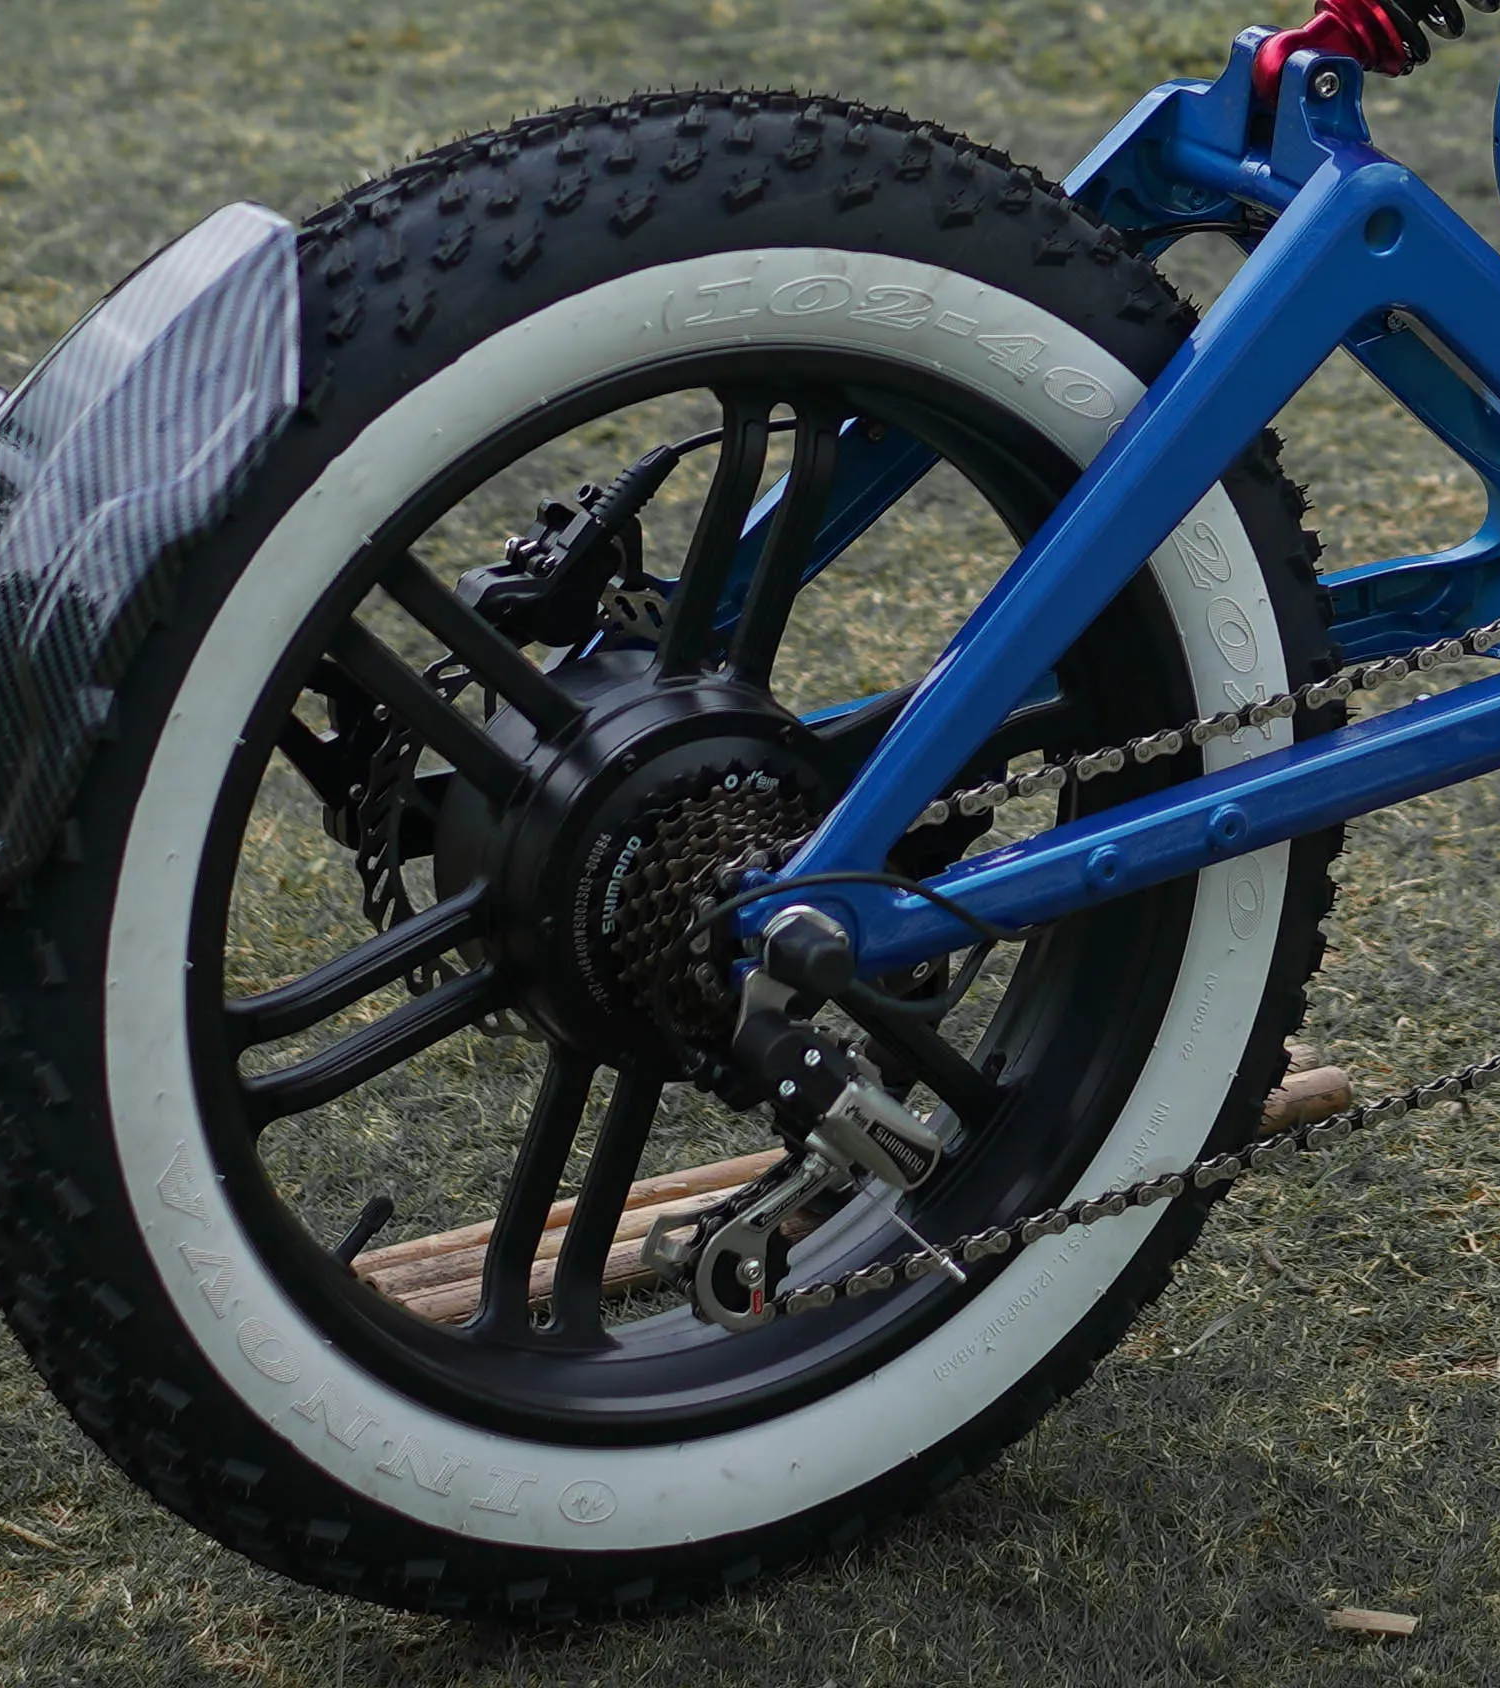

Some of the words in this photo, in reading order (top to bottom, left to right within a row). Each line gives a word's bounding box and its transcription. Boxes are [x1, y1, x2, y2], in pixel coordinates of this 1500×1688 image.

[601, 835, 642, 936] SHIMANO
[874, 1125, 926, 1171] SHIMANO
[156, 1140, 539, 1517] INNOVA
